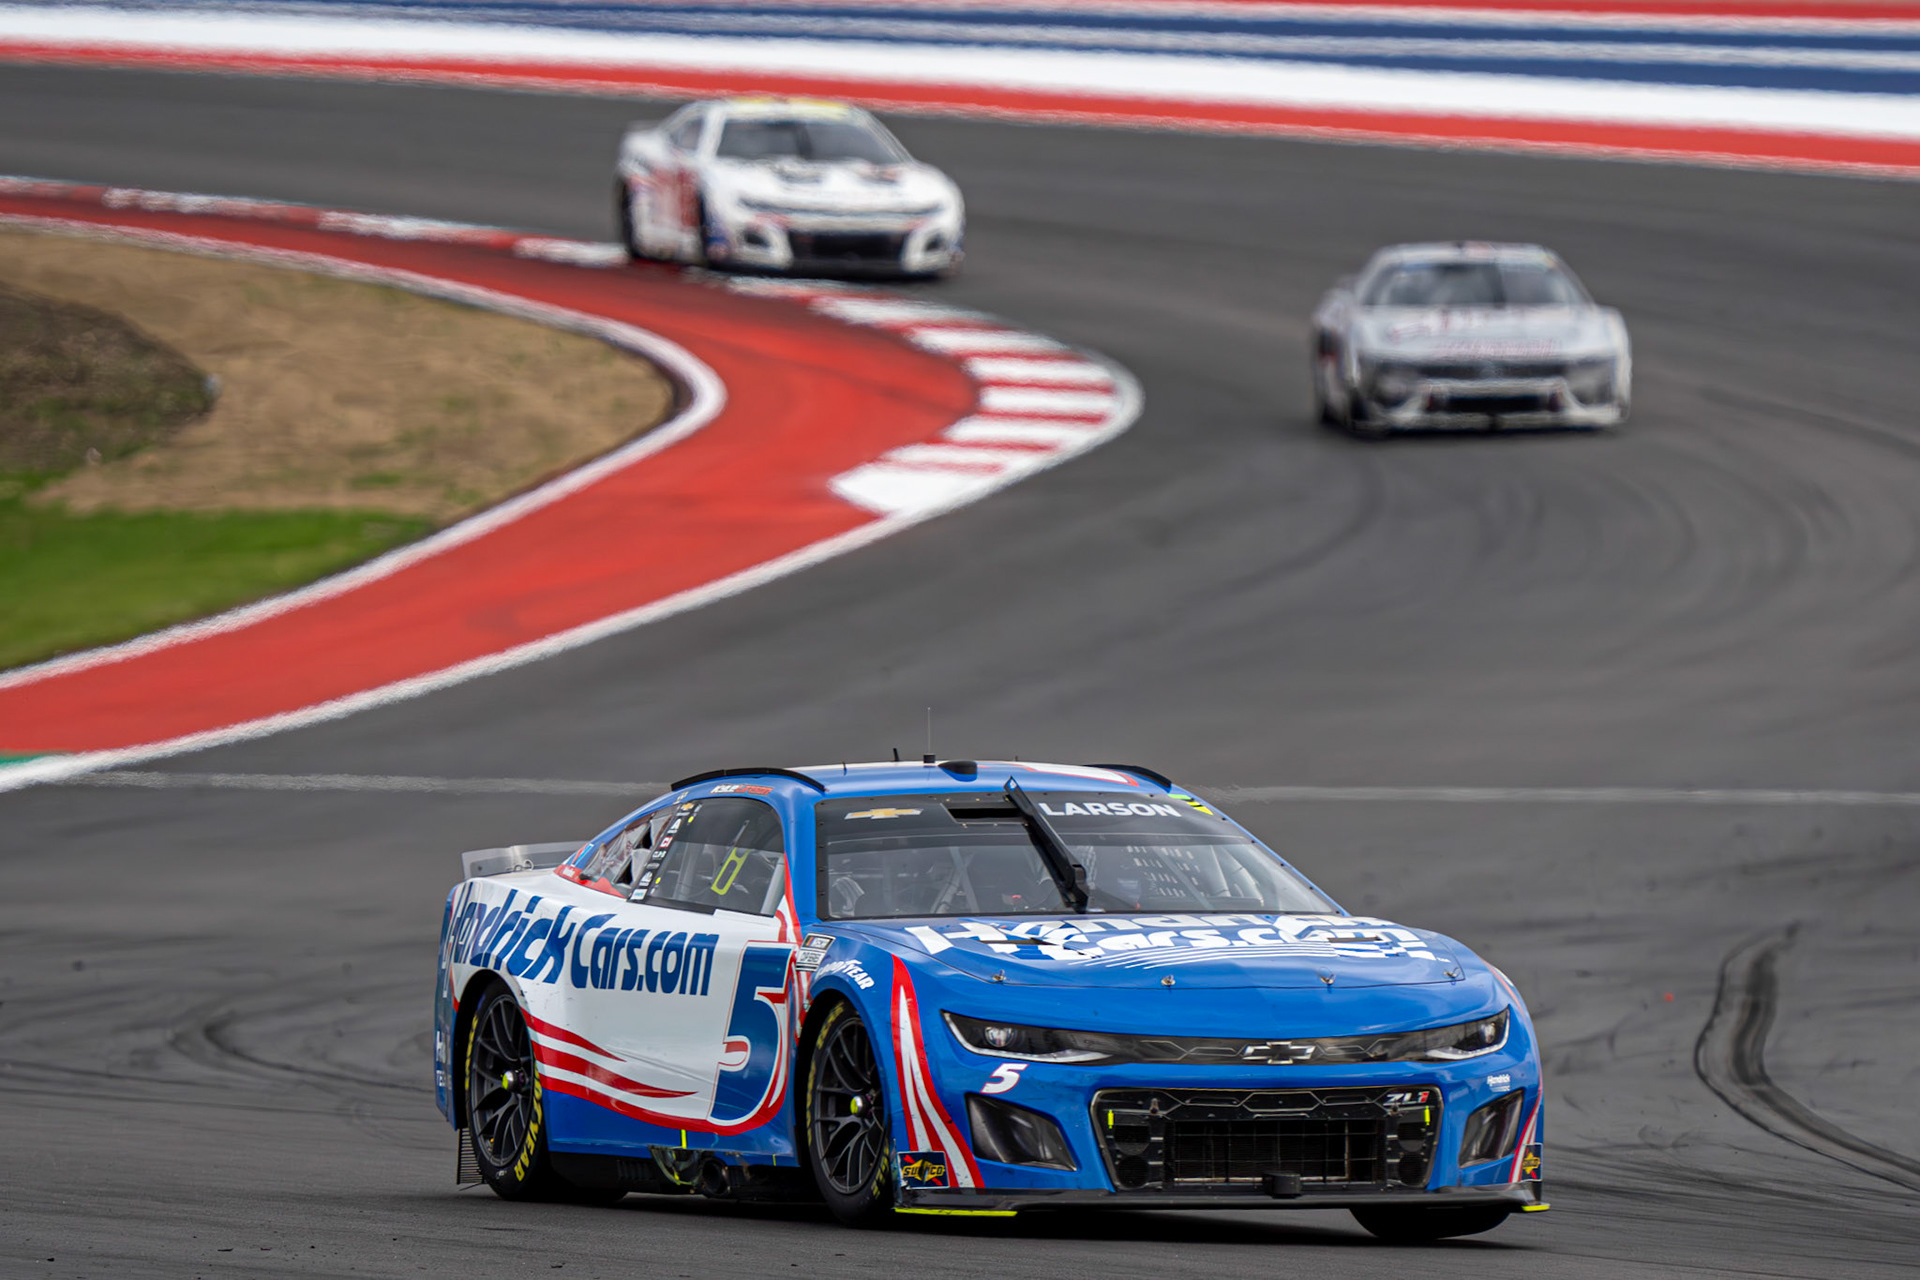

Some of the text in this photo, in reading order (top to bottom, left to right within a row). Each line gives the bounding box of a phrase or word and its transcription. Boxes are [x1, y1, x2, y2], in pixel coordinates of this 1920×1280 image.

[1038, 802, 1182, 817] LARSON
[707, 946, 794, 1124] 5
[980, 1063, 1030, 1094] 5
[1383, 1091, 1430, 1106] ZL1
